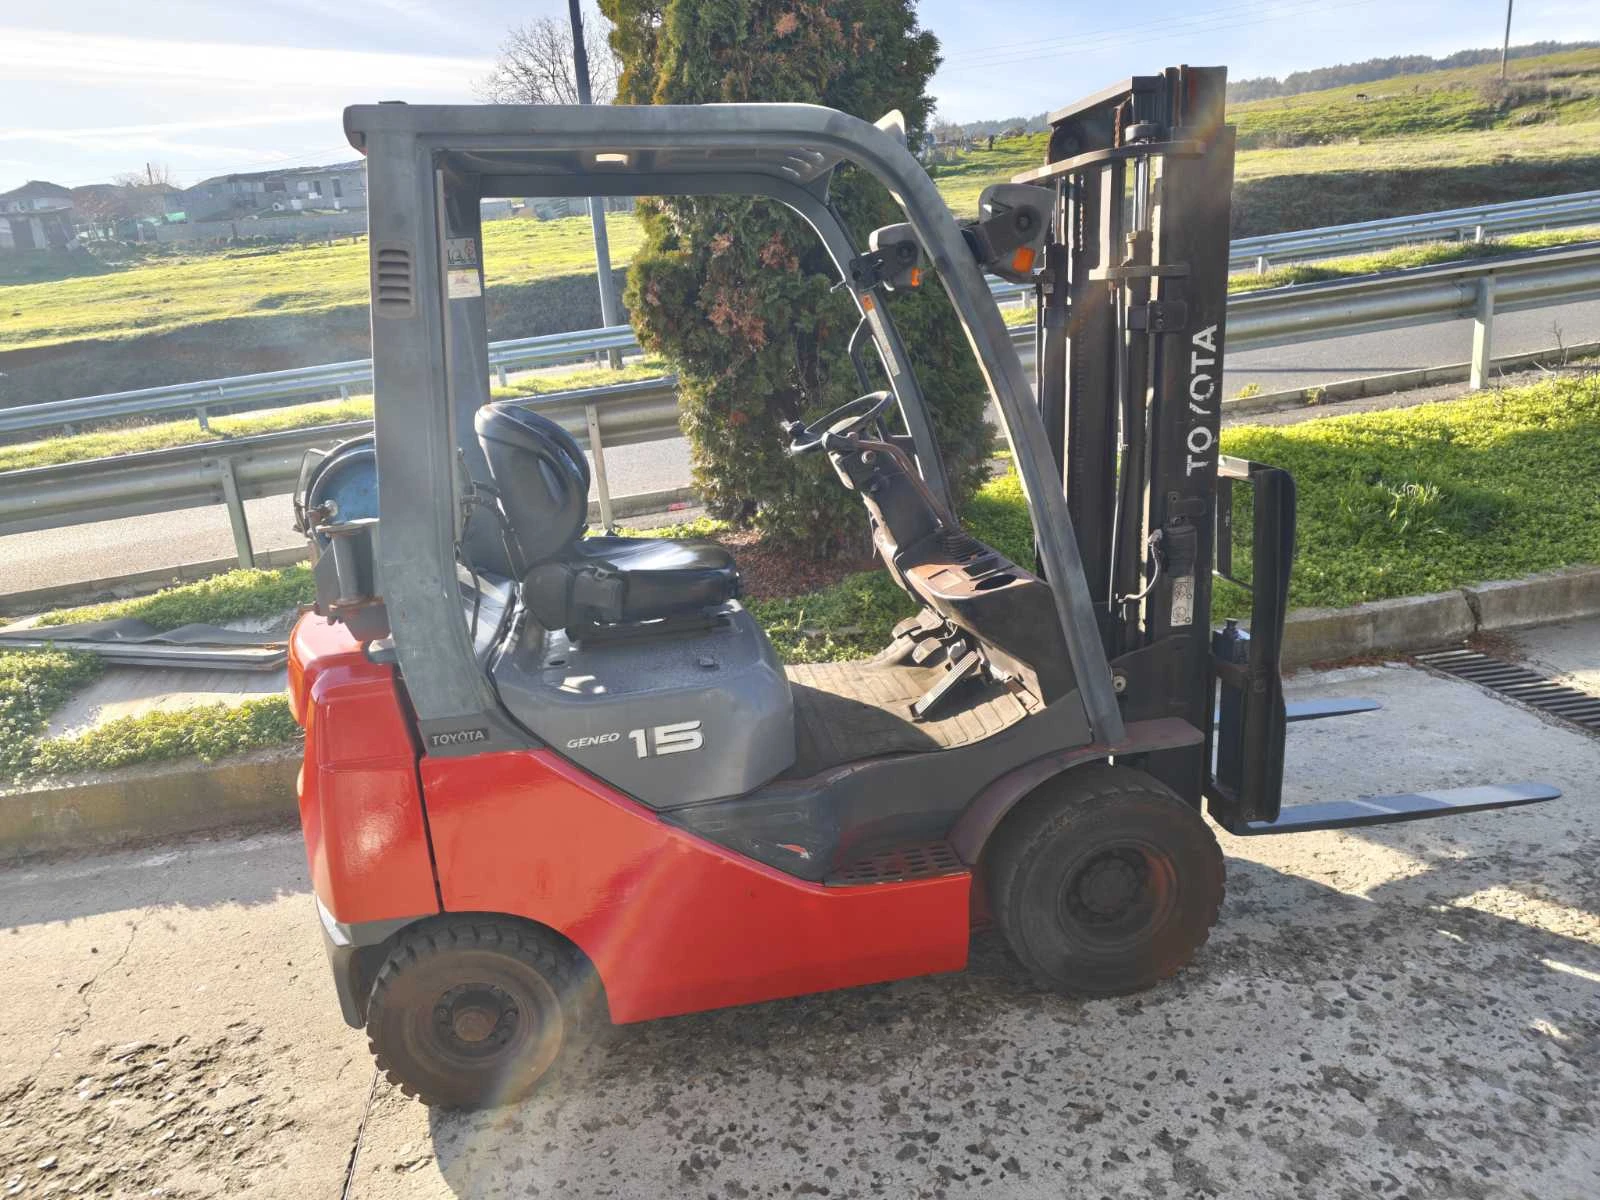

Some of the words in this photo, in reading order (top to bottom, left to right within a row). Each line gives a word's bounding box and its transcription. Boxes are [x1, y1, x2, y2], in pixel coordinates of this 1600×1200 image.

[1186, 324, 1218, 477] TOYOTA
[431, 730, 486, 746] TOYOTA
[567, 732, 621, 749] GENEO
[628, 720, 704, 760] 15
